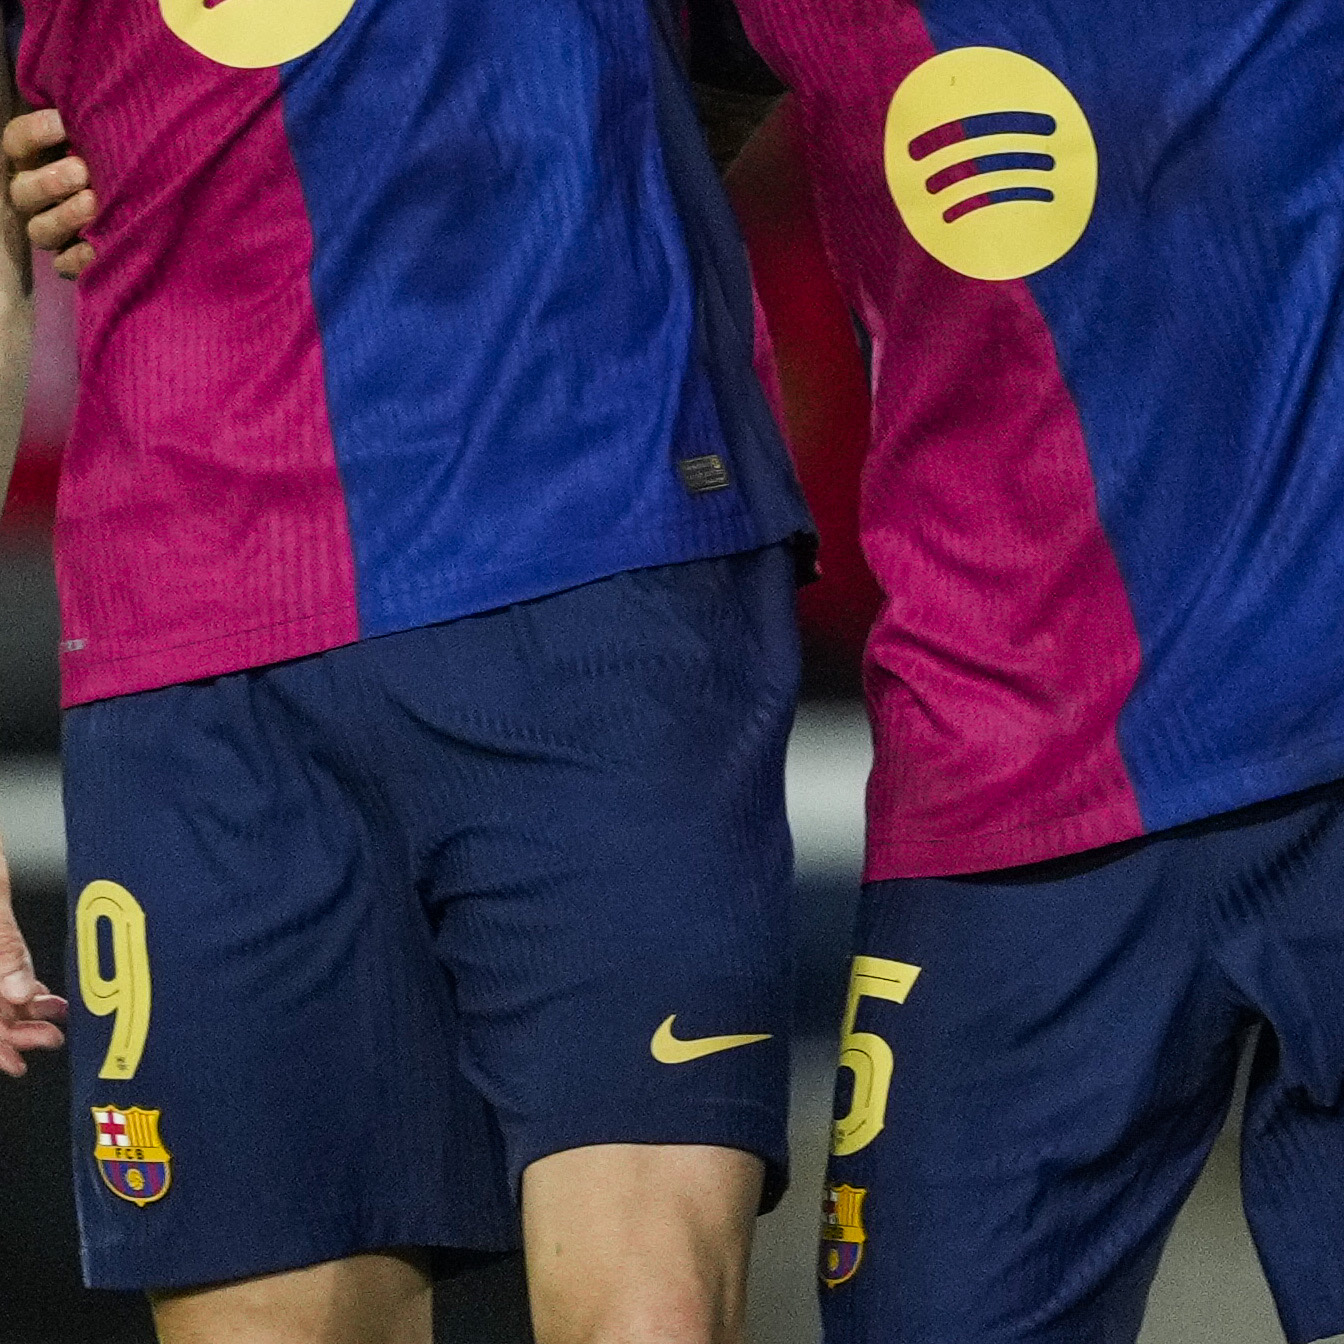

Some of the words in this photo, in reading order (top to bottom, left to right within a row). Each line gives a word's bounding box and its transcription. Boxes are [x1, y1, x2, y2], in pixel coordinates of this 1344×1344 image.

[76, 879, 152, 1079] 9
[830, 955, 922, 1157] 5
[116, 1147, 144, 1160] FCB
